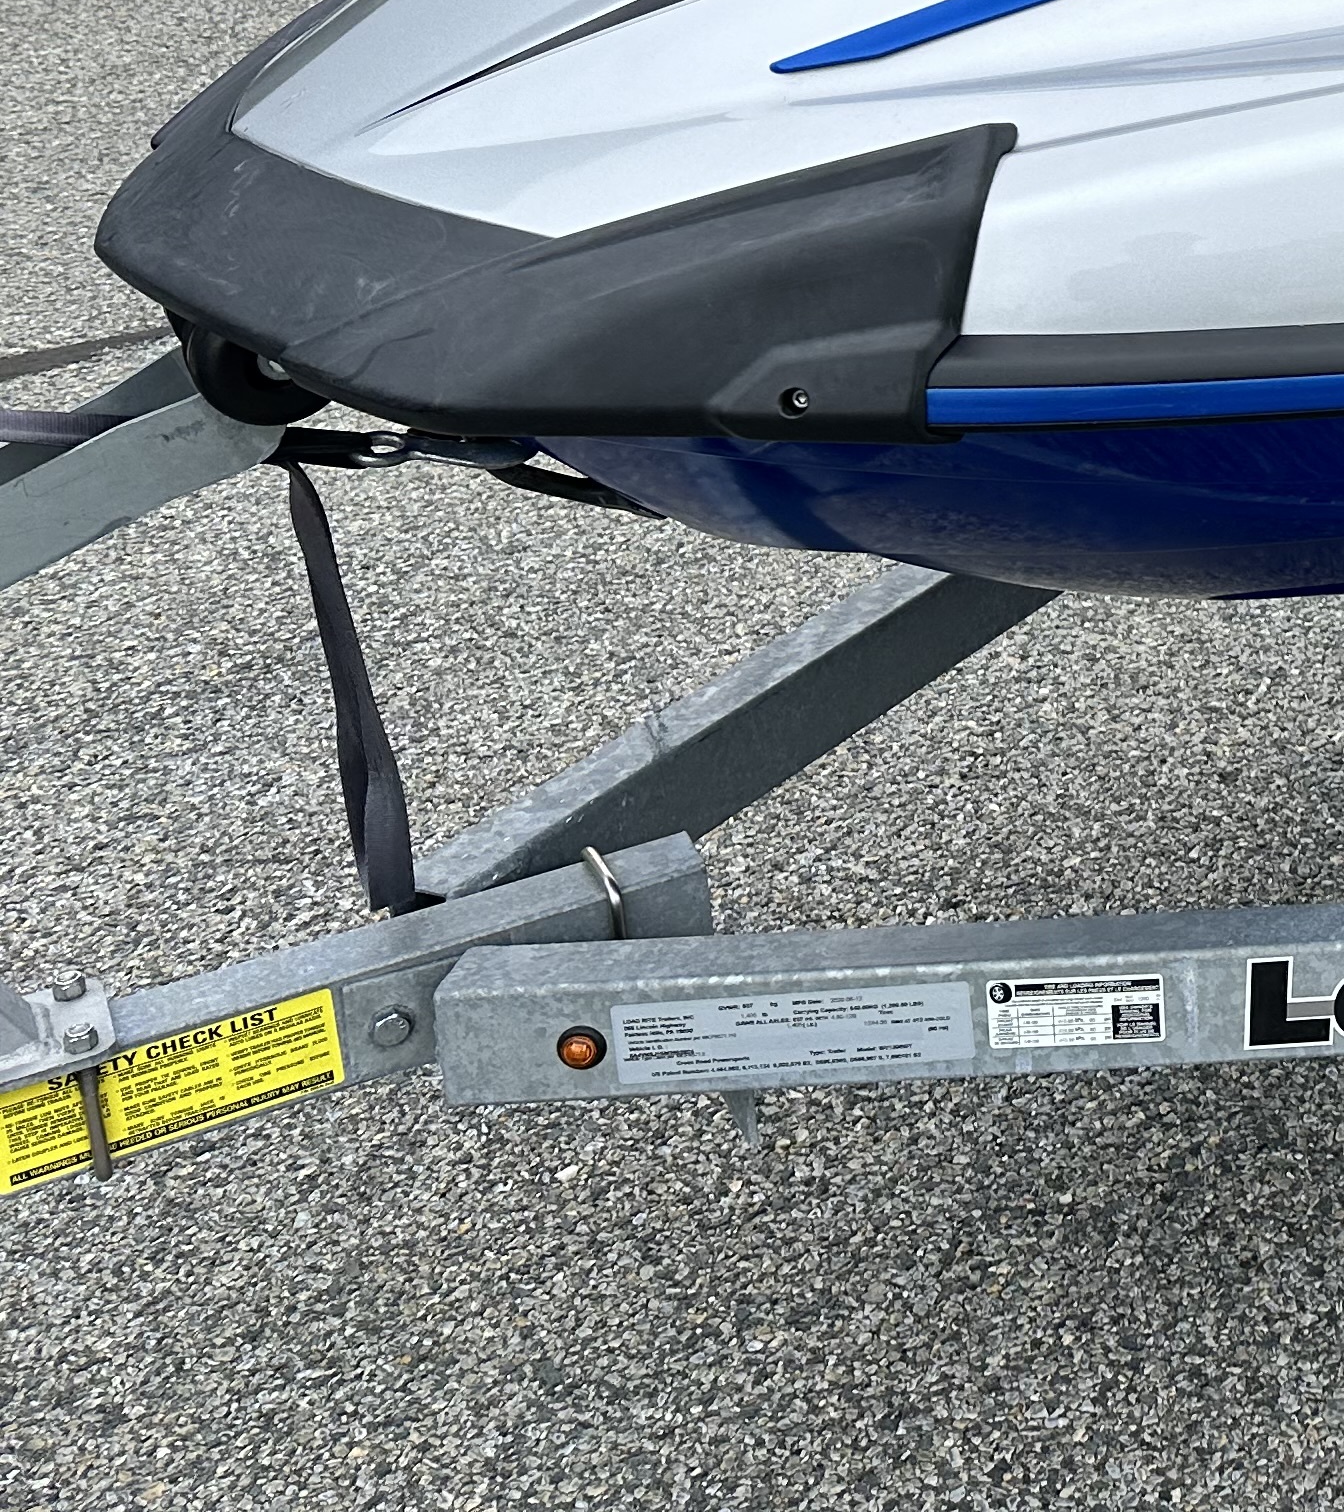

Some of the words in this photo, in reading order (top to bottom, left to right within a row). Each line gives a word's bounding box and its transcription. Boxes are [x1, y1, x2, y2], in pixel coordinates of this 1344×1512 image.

[47, 1051, 138, 1090] SAETY
[146, 1028, 223, 1060] CHECK
[230, 1007, 277, 1033] LIST
[12, 1174, 28, 1183] ALL
[29, 1158, 78, 1177] WARNINGS
[80, 1154, 92, 1162] MU
[155, 1126, 167, 1136] OR
[169, 1114, 206, 1131] SERIOUS
[206, 1098, 249, 1120] PERSONAL
[250, 1089, 281, 1104] INJURY
[282, 1084, 300, 1095] MAY
[301, 1073, 332, 1088] RESULT
